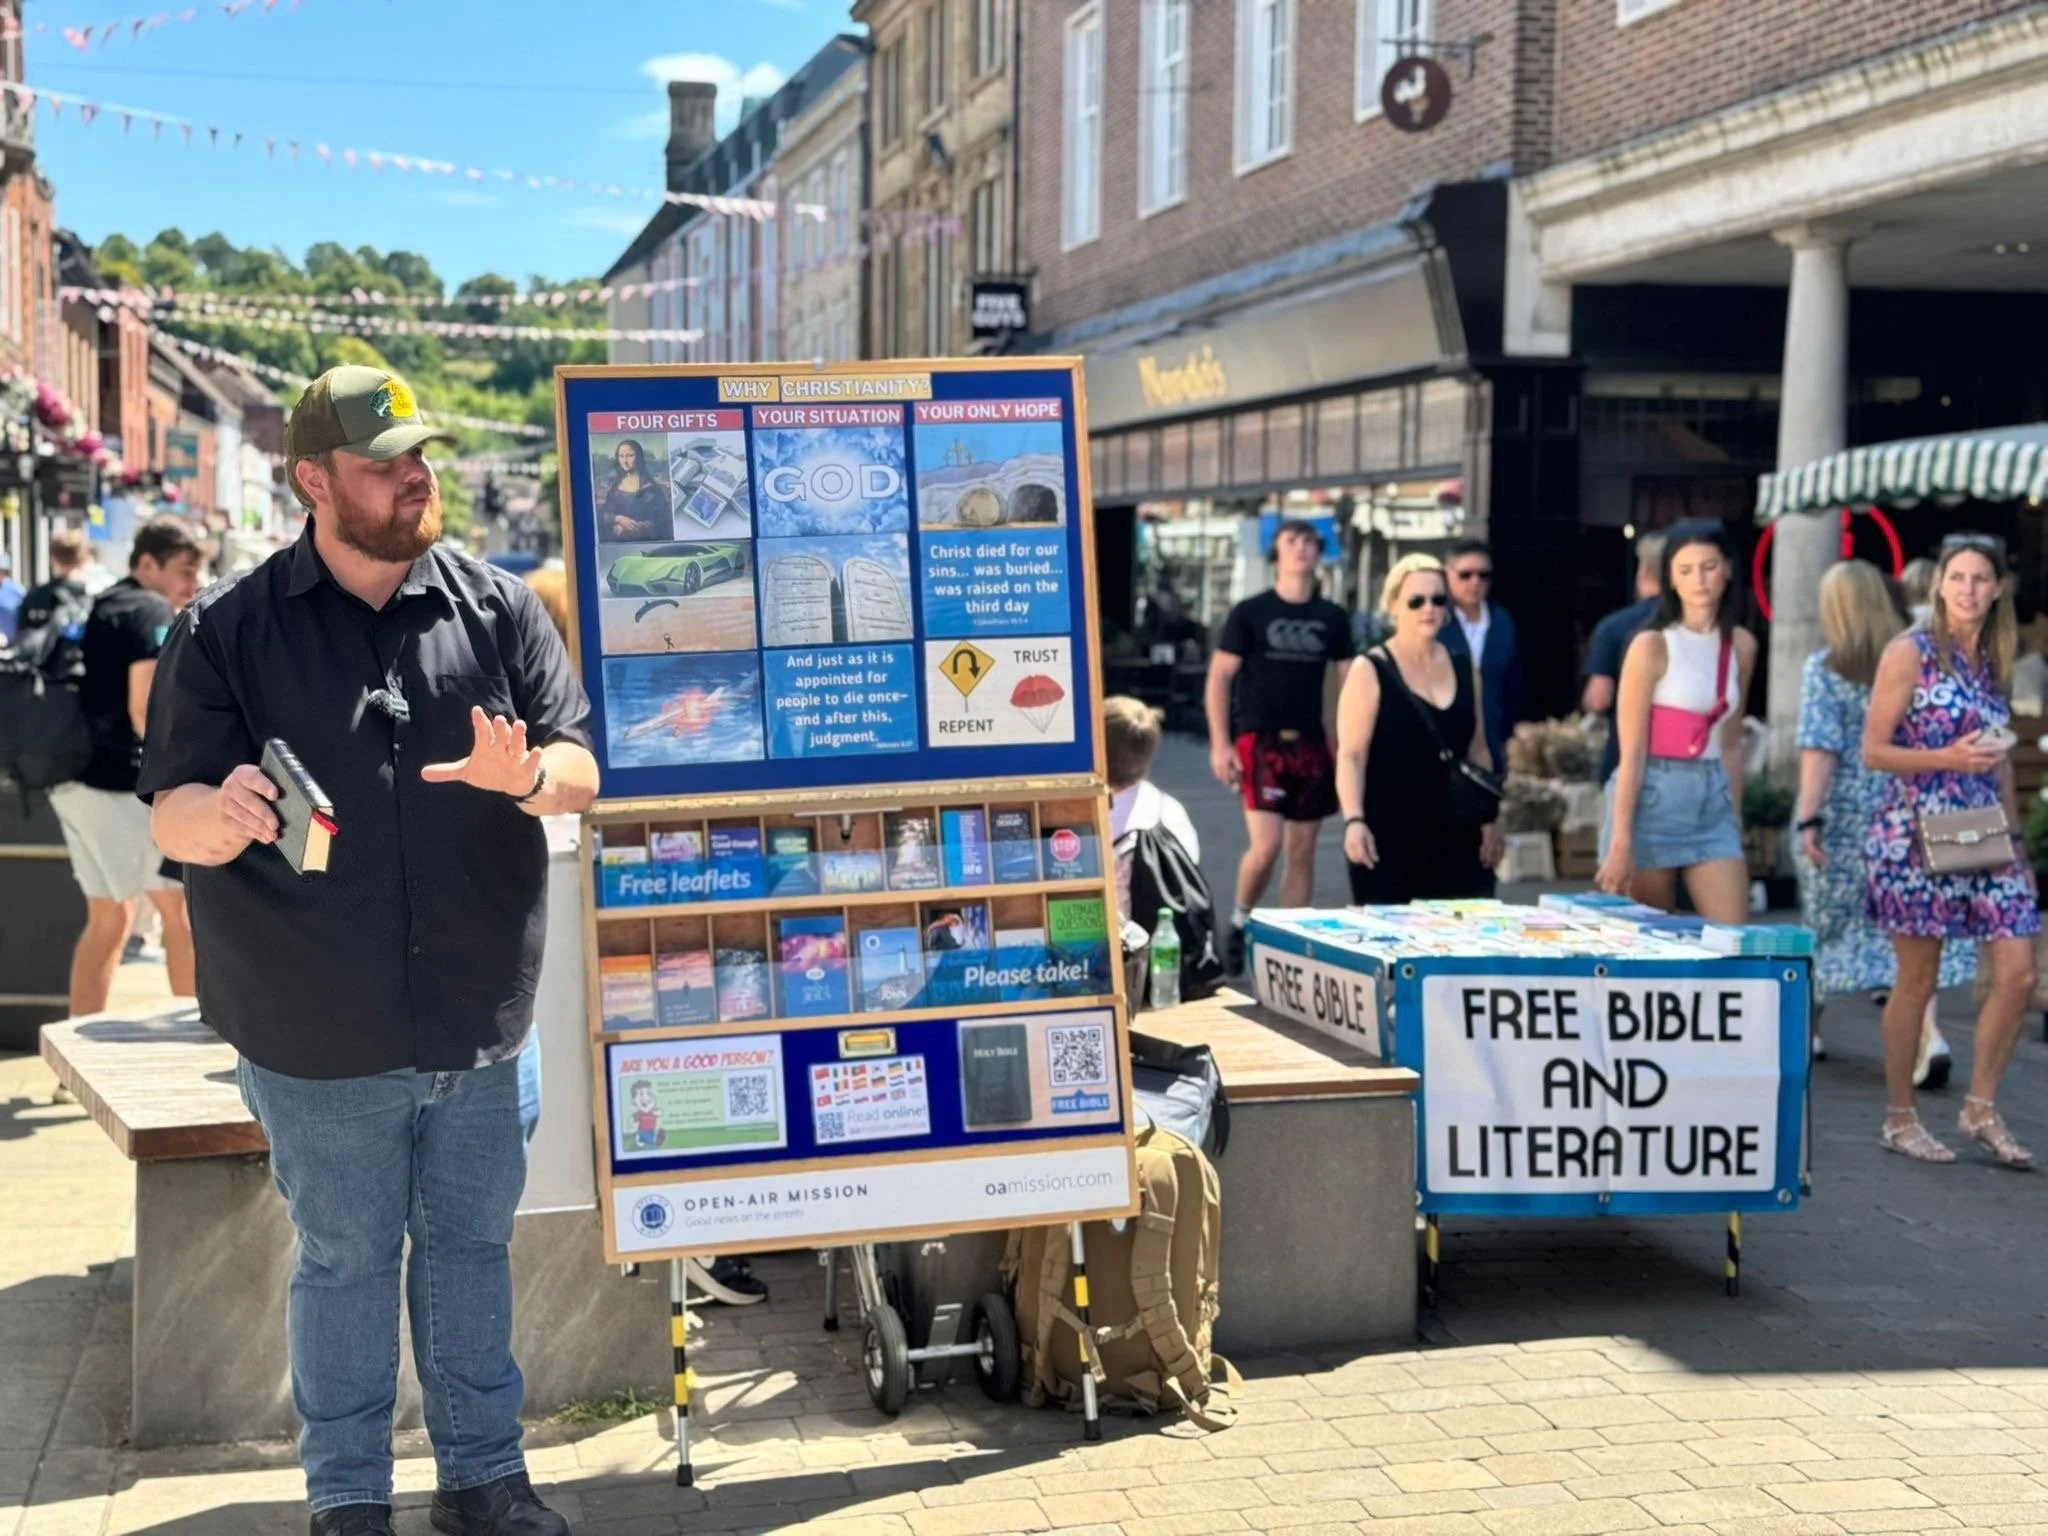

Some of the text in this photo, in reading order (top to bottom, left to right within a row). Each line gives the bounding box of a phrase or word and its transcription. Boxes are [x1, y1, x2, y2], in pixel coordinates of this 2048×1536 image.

[723, 378, 930, 398] WHY CHRISTIANITY?
[758, 408, 900, 425] YOUR SITUATION
[919, 403, 1059, 419] YOUR ONLY HOPE
[617, 413, 718, 429] FOUR GIFTS
[763, 464, 901, 502] GOD
[929, 543, 1059, 559] Christ died for our
[928, 562, 1063, 578] sins... was buried...
[934, 580, 1059, 596] was raised on the
[965, 599, 1030, 614] third day
[786, 651, 894, 669] And just as it is
[1014, 649, 1059, 663] TRUST
[795, 671, 888, 689] appointed for
[776, 693, 821, 710] people
[825, 694, 839, 705] to
[844, 691, 864, 704] die
[795, 710, 892, 726] and after this,
[938, 719, 994, 734] REPENT
[810, 730, 879, 748] judgment.
[619, 869, 751, 896] Free leaflets
[964, 959, 1090, 988] Please take!
[1265, 957, 1367, 1036] FREE BIBLE
[1463, 988, 1744, 1042] FREE BIBLE
[620, 1049, 775, 1074] ARE YOU A GOOD PERSON?
[1542, 1057, 1668, 1110] AND
[847, 1105, 928, 1122] Read online!
[1449, 1124, 1760, 1179] LITERATURE
[985, 1171, 1113, 1196] oamission.com
[684, 1184, 869, 1212] OPEN-AIR MISSION
[685, 1207, 805, 1227] Good news on the streets
